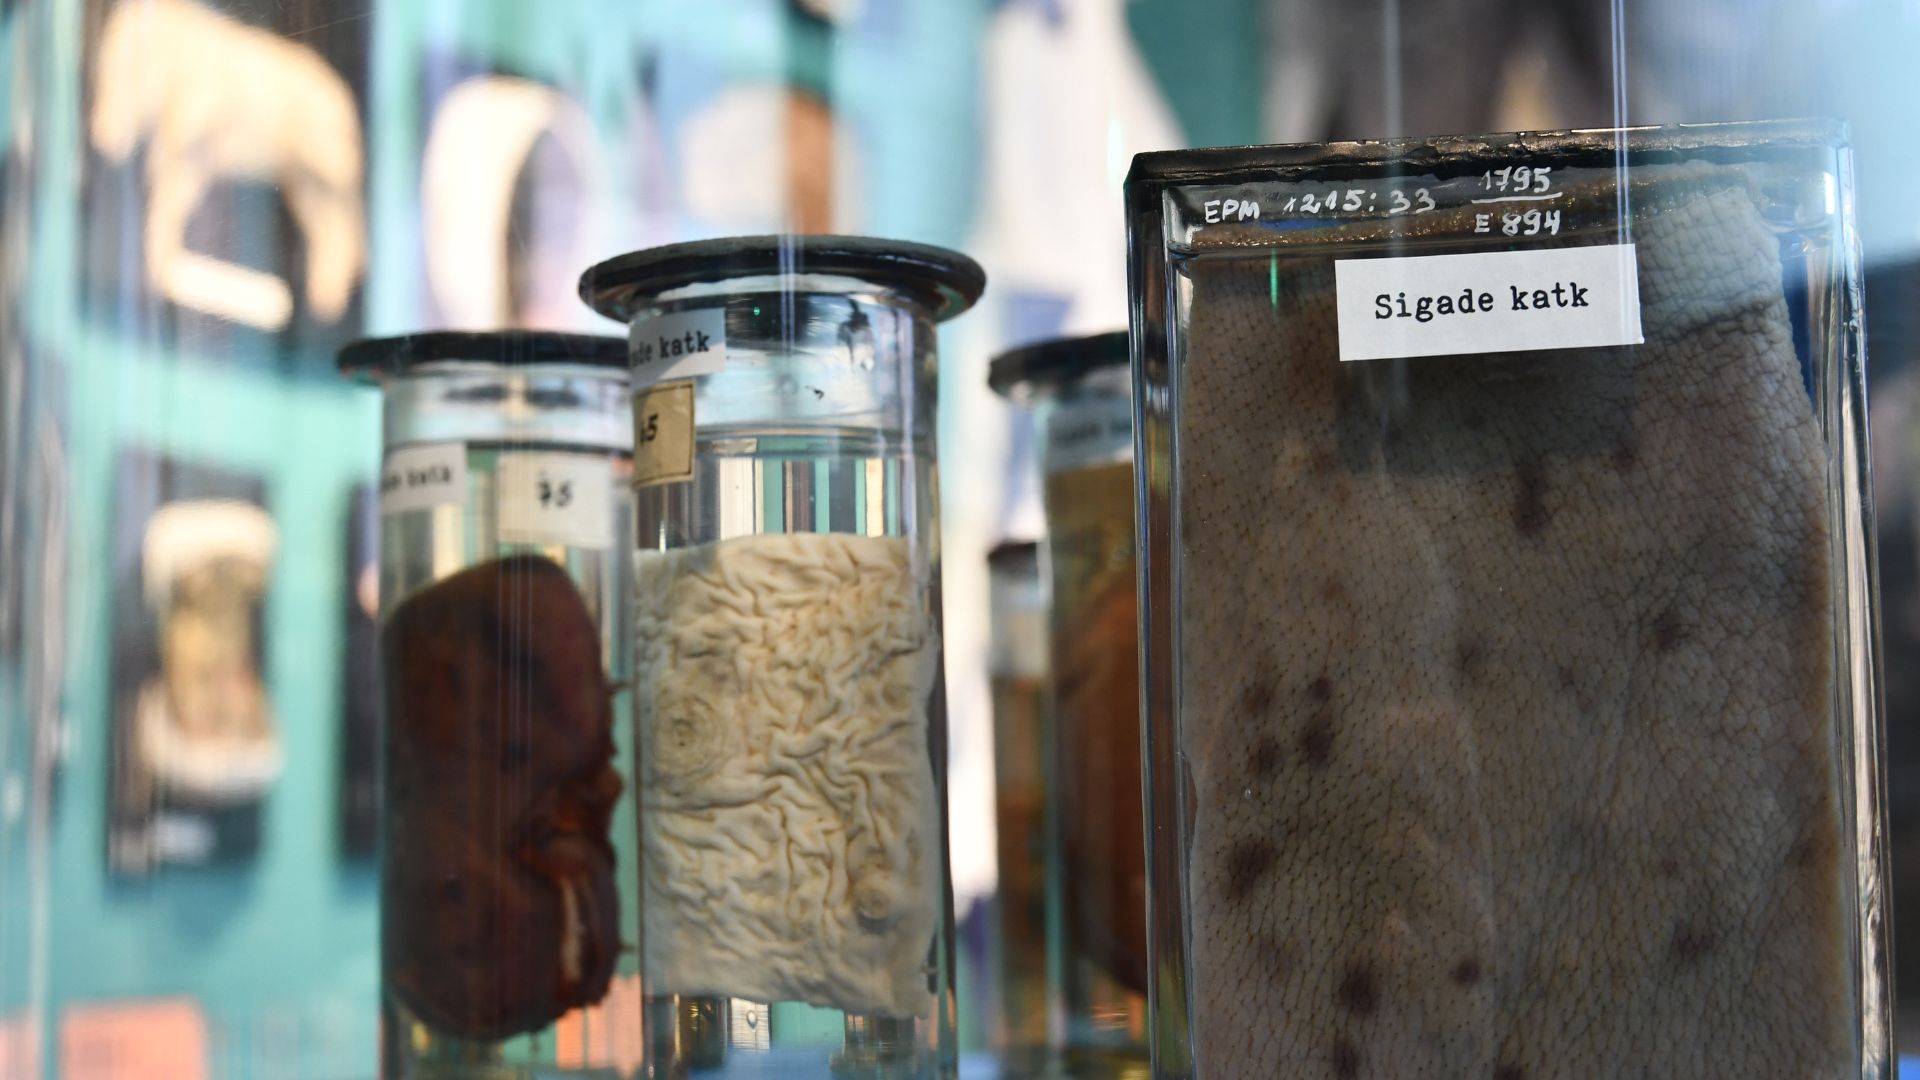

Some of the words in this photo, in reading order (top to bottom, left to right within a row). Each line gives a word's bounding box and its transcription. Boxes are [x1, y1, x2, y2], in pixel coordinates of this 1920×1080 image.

[1478, 165, 1552, 194] 1795
[1204, 199, 1260, 224] EPM
[1474, 213, 1490, 233] E
[1501, 208, 1561, 237] 894
[1375, 288, 1494, 323] Sigade
[1510, 281, 1589, 311] katk
[658, 329, 711, 359] katk
